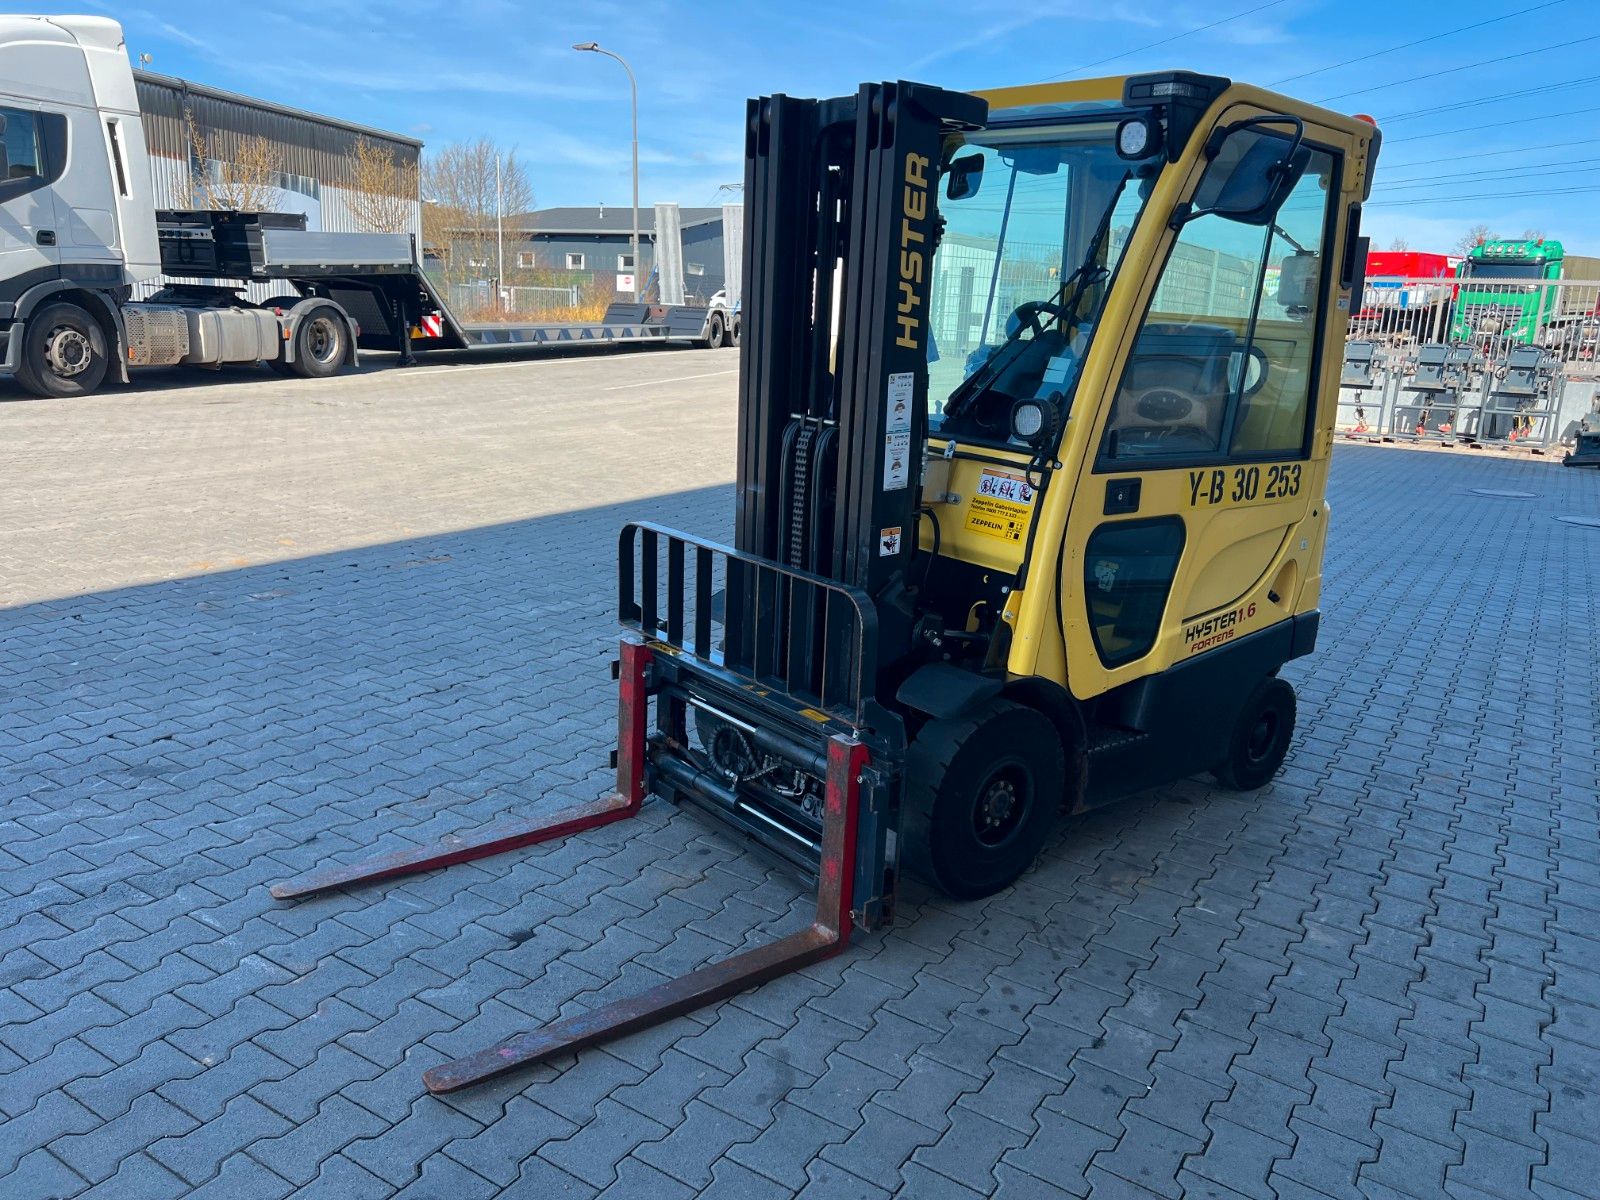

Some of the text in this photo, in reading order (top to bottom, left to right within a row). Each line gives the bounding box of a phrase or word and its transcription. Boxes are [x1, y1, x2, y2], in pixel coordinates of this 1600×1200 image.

[896, 152, 929, 349] HYSTER
[1189, 464, 1302, 506] Y-B 30 253
[971, 518, 1003, 530] ZEPPELIN
[1185, 602, 1257, 644] HYSTER 1.6
